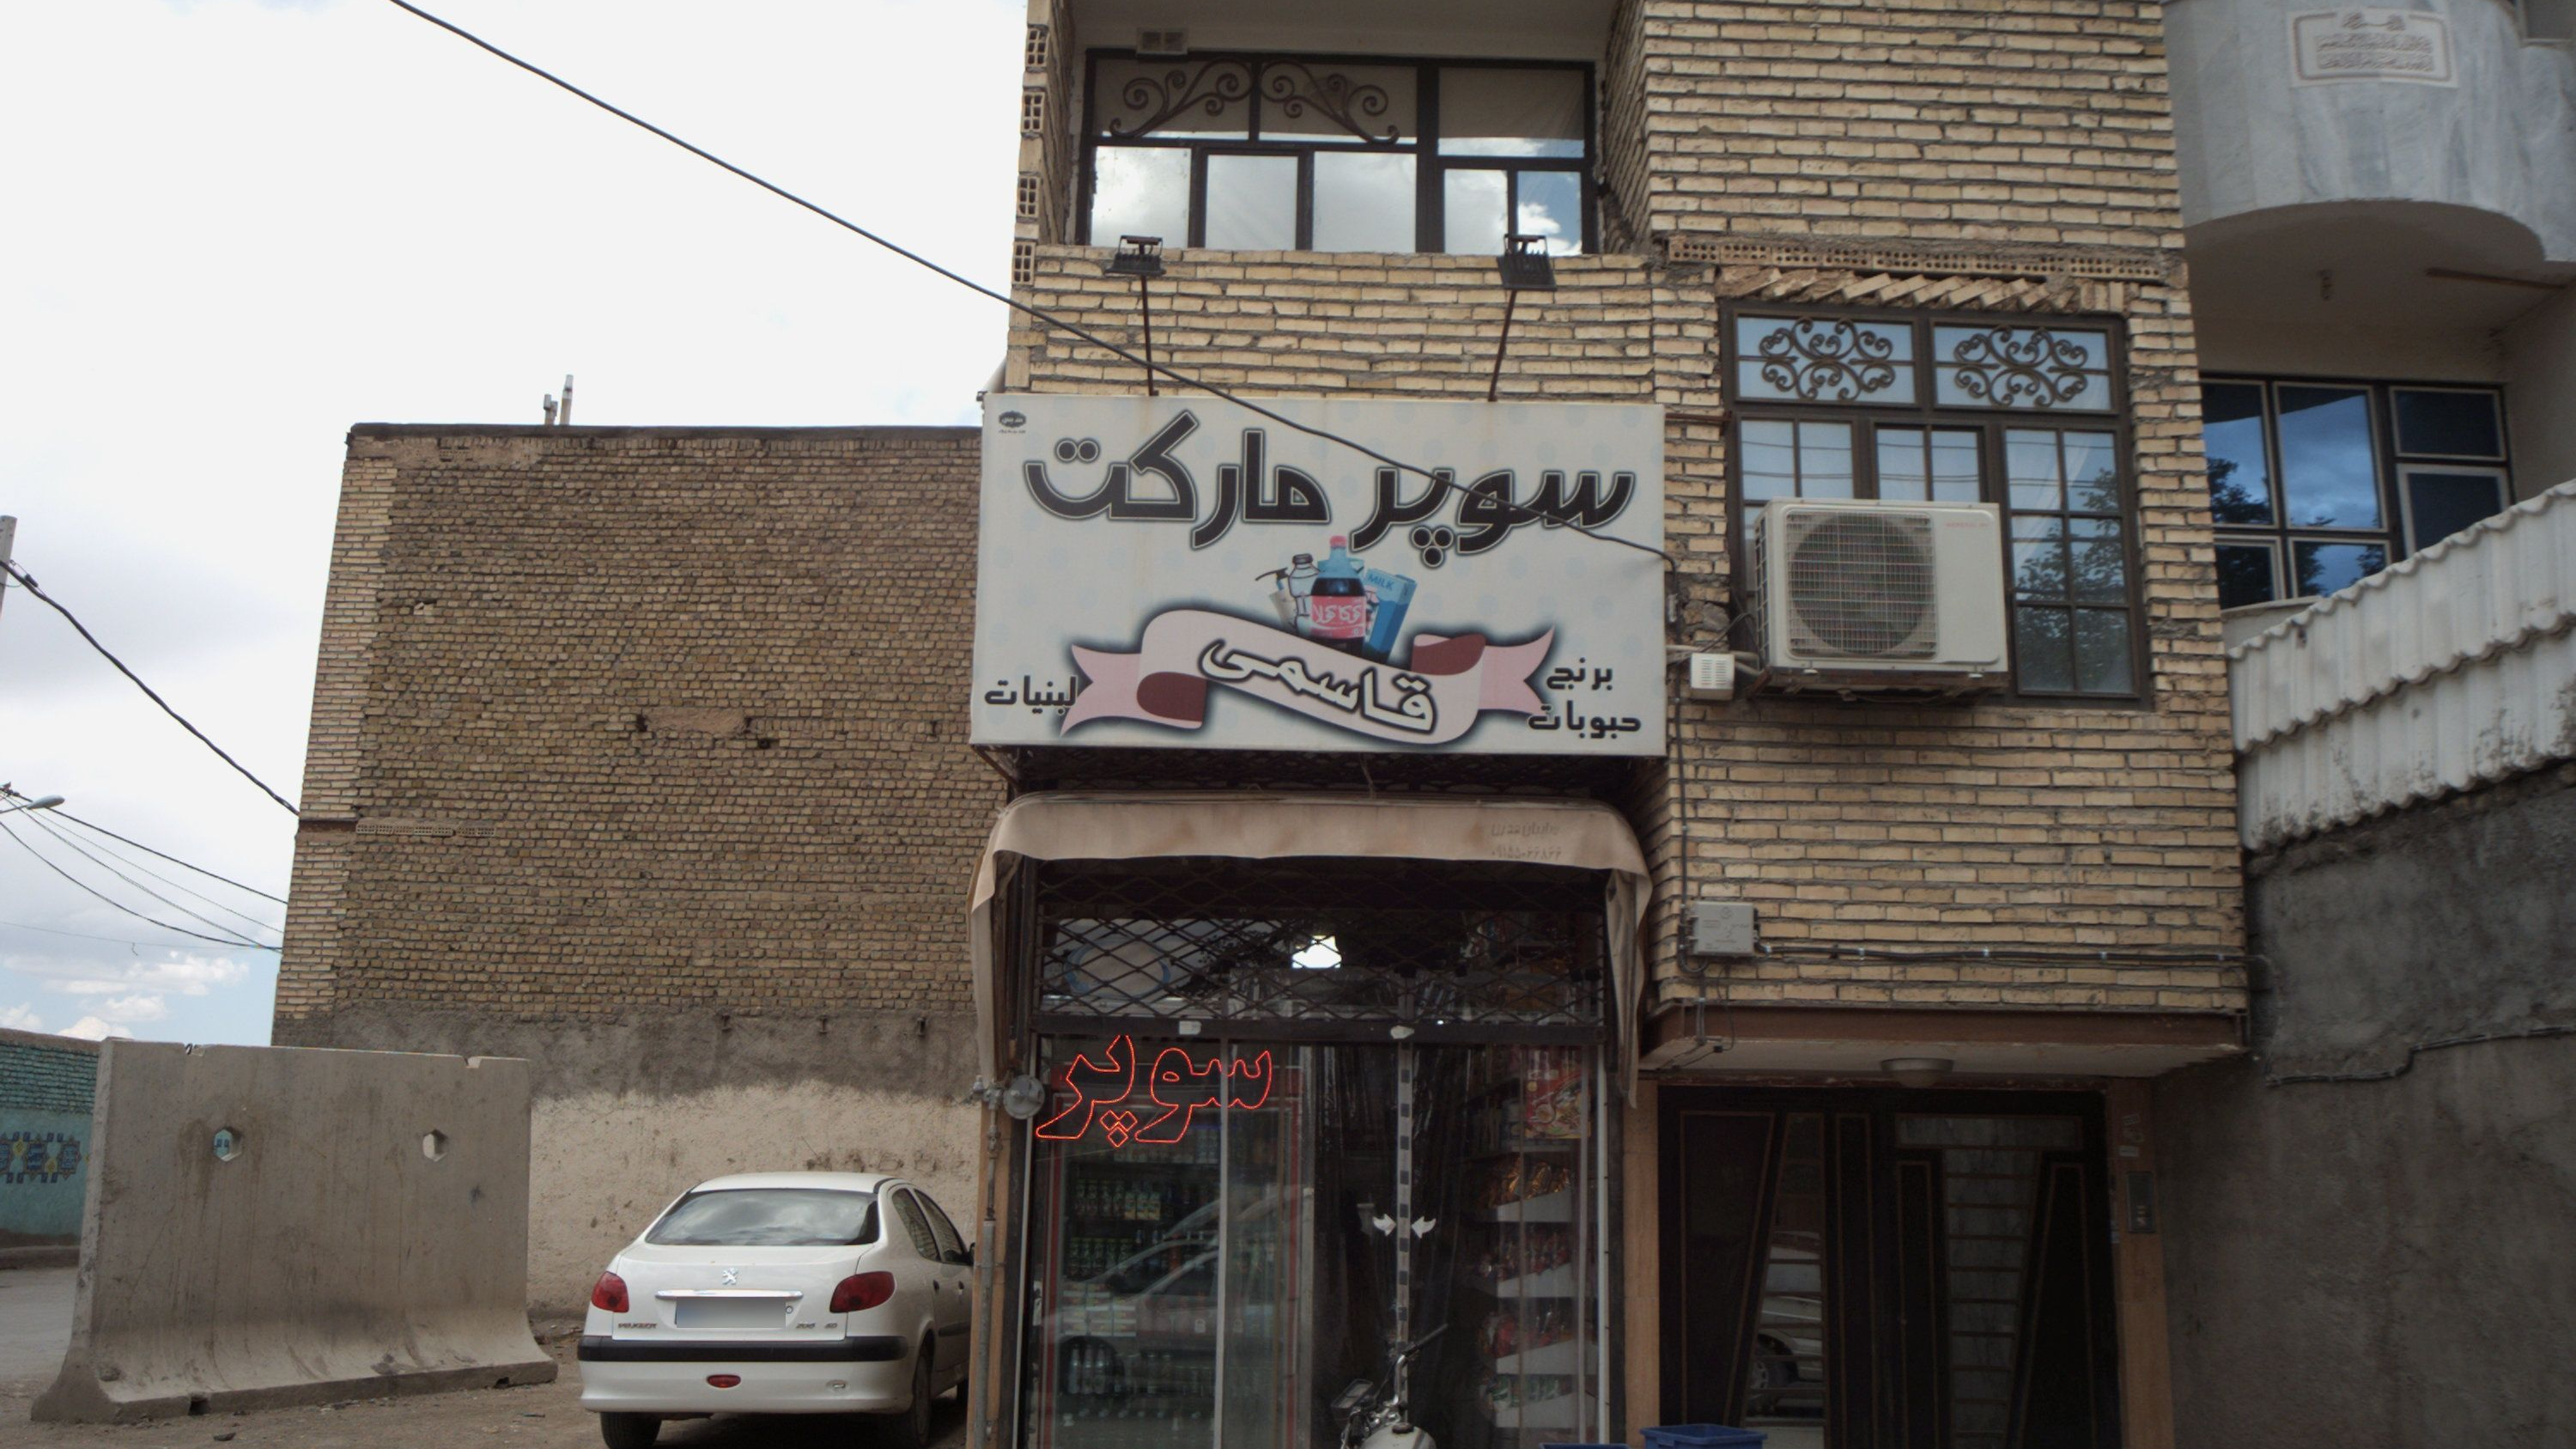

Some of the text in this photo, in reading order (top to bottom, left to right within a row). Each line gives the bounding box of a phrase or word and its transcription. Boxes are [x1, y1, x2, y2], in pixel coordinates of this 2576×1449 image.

[1024, 410, 1635, 569] سوپر مارکت
[1367, 574, 1394, 591] MILK
[984, 674, 1078, 715] لبنیات
[1199, 640, 1438, 734] قاسمی
[1546, 657, 1613, 691] برنج
[1528, 700, 1642, 740] حبوبات
[1036, 1034, 1273, 1148] سوپر
